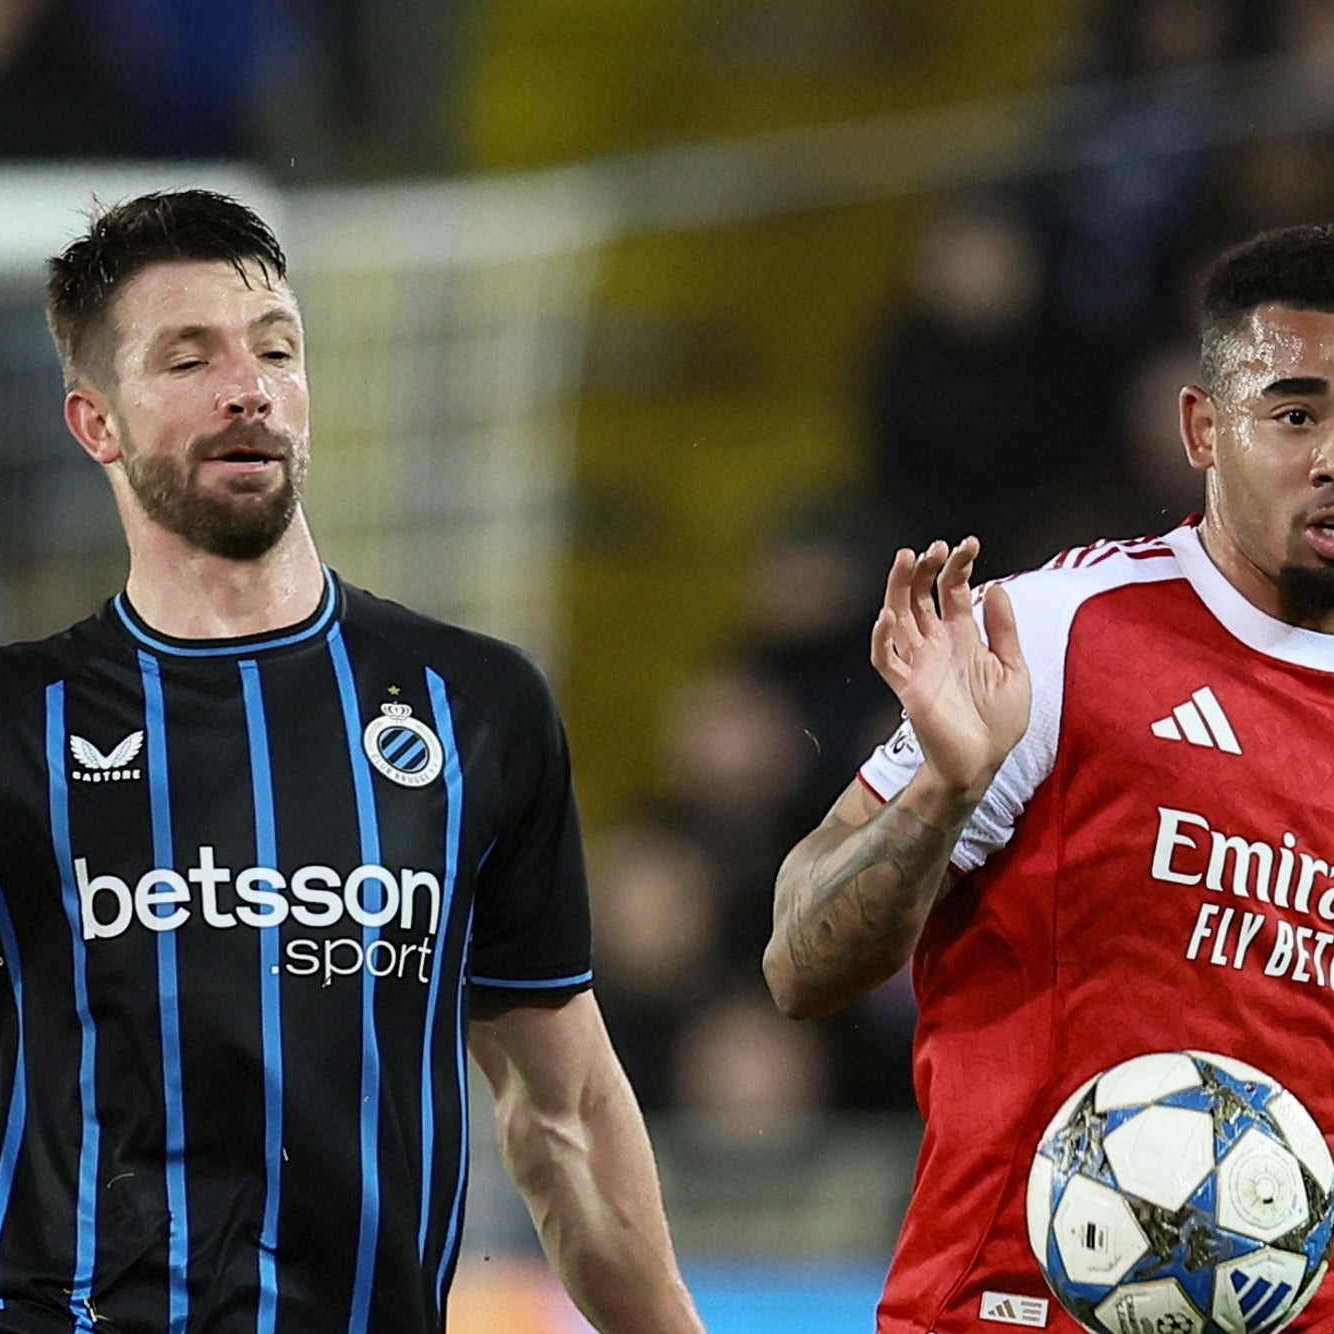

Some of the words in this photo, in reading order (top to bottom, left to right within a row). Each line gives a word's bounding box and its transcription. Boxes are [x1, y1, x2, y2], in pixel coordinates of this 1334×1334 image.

[72, 769, 141, 783] CASTORE
[73, 845, 441, 940] betsson
[270, 935, 433, 988] .sport
[1185, 902, 1265, 970] FLY
